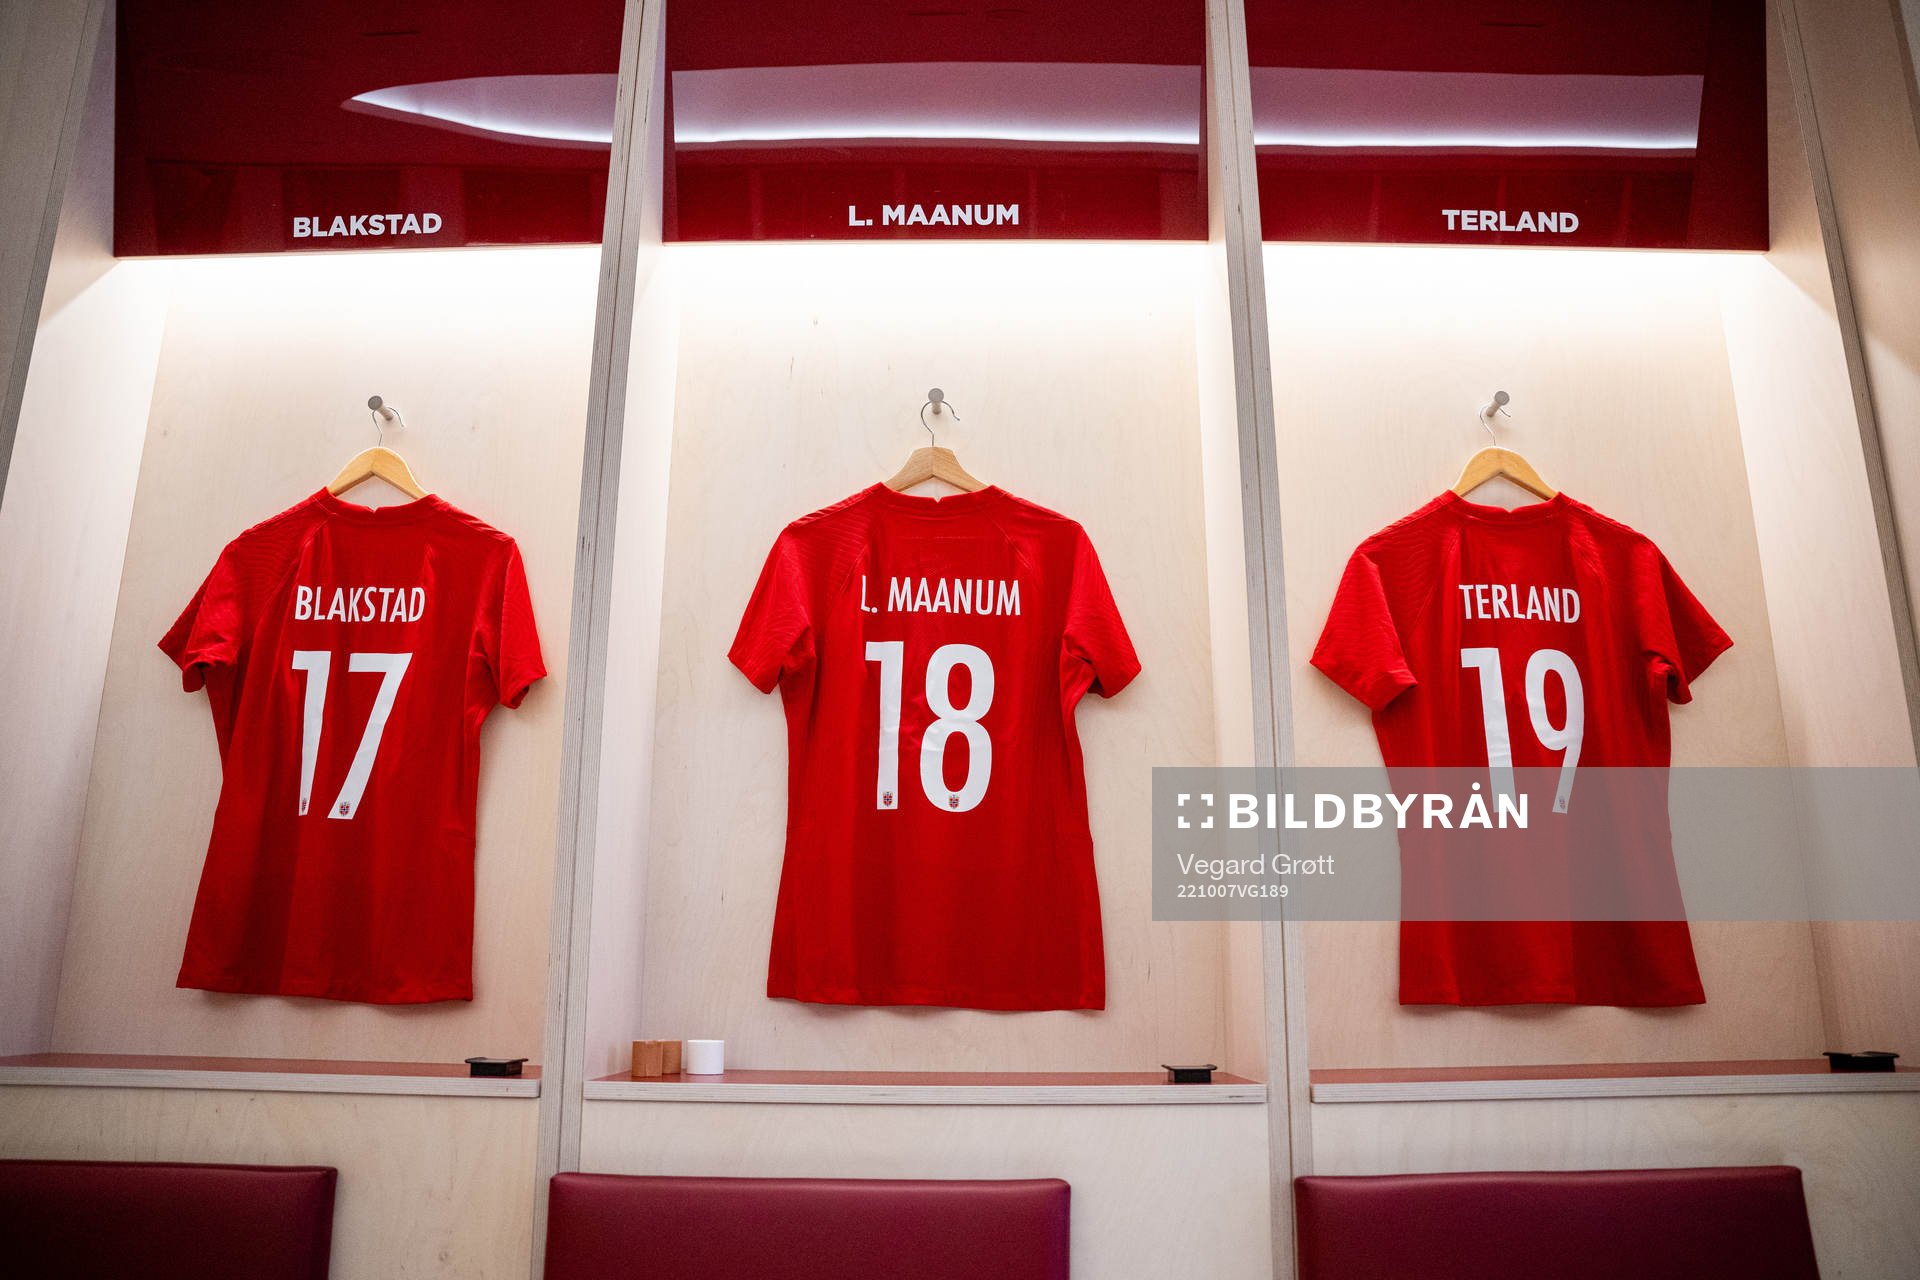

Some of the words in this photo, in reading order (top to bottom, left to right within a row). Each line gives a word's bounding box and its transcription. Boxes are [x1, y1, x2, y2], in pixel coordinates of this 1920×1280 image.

[294, 213, 441, 237] BLAKSTAD
[849, 206, 872, 226] L.
[883, 205, 1018, 225] MAANUM
[1442, 210, 1578, 232] TERLAND
[295, 586, 425, 622] BLAKSTAD
[861, 575, 877, 613] L.
[888, 577, 1020, 615] MAANUM
[1459, 584, 1580, 622] TERLAND
[292, 651, 412, 819] 17
[866, 641, 994, 812] 18
[1461, 648, 1584, 813] 19
